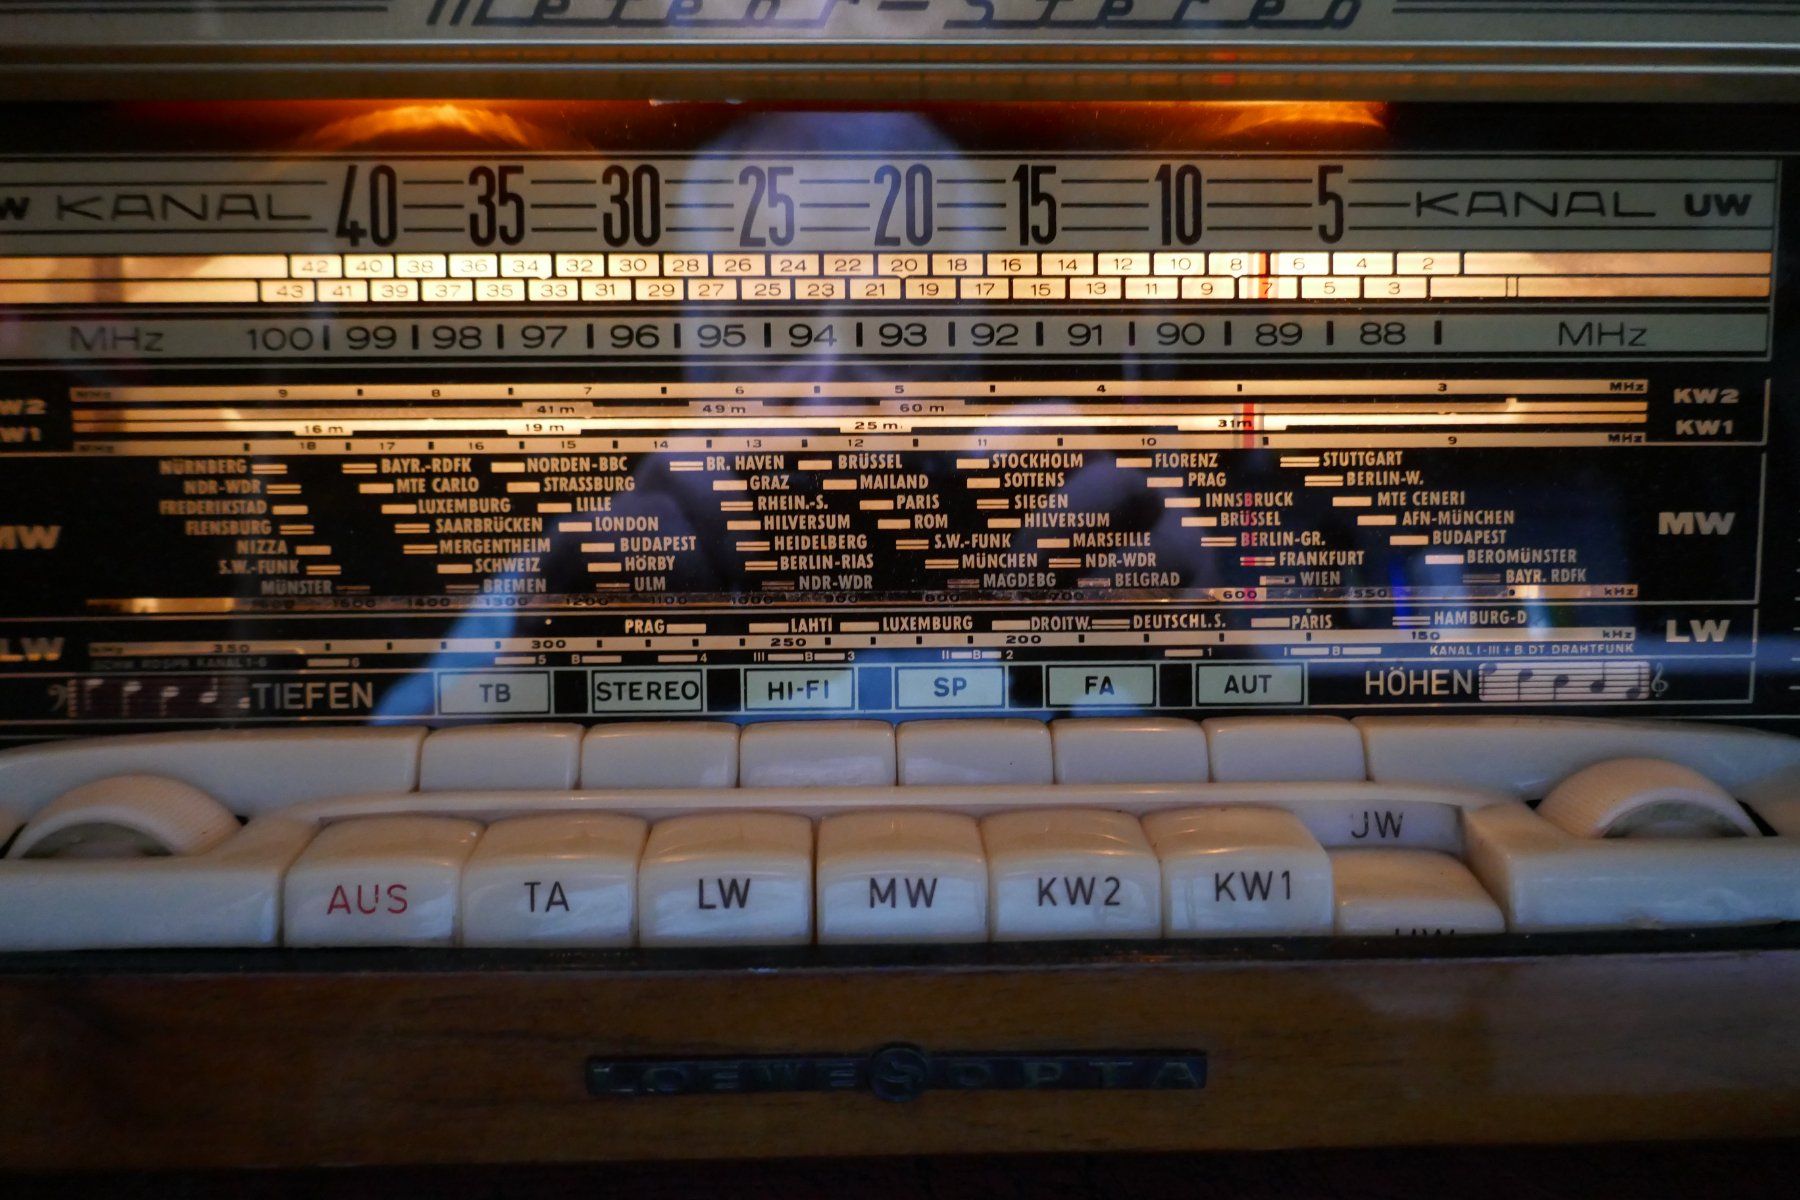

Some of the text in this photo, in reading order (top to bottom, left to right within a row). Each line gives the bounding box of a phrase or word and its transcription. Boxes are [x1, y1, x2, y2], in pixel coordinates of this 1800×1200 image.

[56, 164, 1752, 247] KANAL 40 35 30 25 20 15 10 5 KANAL UW
[672, 258, 1021, 272] 28 26 24 22 20 18 16
[648, 283, 995, 297] 29 27 25 23 21 19 17
[69, 321, 1646, 352] MHz 100 99 98 97 96 95 94 93 92 91 90 89 88 MHz
[1610, 382, 1644, 391] MHz
[1674, 388, 1739, 404] KW2
[537, 405, 554, 414] 41
[702, 405, 725, 414] 49
[900, 404, 923, 413] 60
[305, 425, 322, 434] 16
[525, 424, 543, 432] 19
[855, 422, 877, 430] 25
[1676, 420, 1734, 435] KW1
[300, 433, 1643, 450] 18 17 16 15 14 13 12 10 MHz
[381, 458, 472, 473] BAYR.-RDFK
[527, 456, 628, 472] NORDEN-BBC
[707, 455, 784, 471] BR. HAVEN
[838, 453, 902, 470] BRÜSSEL
[993, 453, 1083, 468] STOCKHOLM
[1155, 453, 1219, 468] FLORENZ
[1323, 451, 1403, 466] STUTTGART
[397, 478, 479, 493] MTE CARLO
[544, 477, 636, 492] STRASSBURG
[750, 475, 790, 490] GRAZ
[860, 474, 929, 489] MAILAND
[1004, 472, 1065, 488] SOTTENS
[1188, 472, 1227, 487] PRAG
[1346, 471, 1424, 486] BERLIN-W.
[184, 480, 261, 494] NDR-WDR
[418, 498, 511, 514] LUXEMBURG
[576, 497, 612, 512] LILLE
[757, 495, 828, 511] RHEIN.-S.
[897, 494, 940, 509] PARIS
[1015, 494, 1069, 509] SIEGEN
[1206, 492, 1293, 507] INNSBRUCK
[1377, 491, 1466, 506] MTE CENERI
[596, 517, 659, 532] LONDON
[764, 515, 850, 531] HILVERSUM
[914, 514, 948, 529] ROM
[1025, 512, 1110, 528] HILVERSUM
[1221, 511, 1281, 526] BRÜSSEL
[1402, 509, 1515, 525] AFN-MÜNCHEN
[1658, 512, 1735, 535] MW
[436, 517, 543, 533] SAARBRÜCKEN
[620, 536, 697, 552] BUDAPEST
[774, 535, 868, 550] HEIDELBERG
[934, 533, 1011, 549] S.W.-FUNK
[1073, 532, 1151, 548] MARSEILLE
[1241, 531, 1326, 546] BERLIN-GR.
[1433, 530, 1507, 545] BUDAPEST
[236, 540, 288, 555] NIZZA
[440, 538, 551, 554] MERGENTHEIM
[625, 555, 675, 571] HÖRBY
[780, 554, 874, 570] BERLIN-RIAS
[962, 553, 1038, 569] MÜNCHEN
[1086, 553, 1156, 568] NDR-WDR
[1279, 551, 1365, 566] FRANKFURT
[1467, 549, 1577, 564] BEROMÜNSTER
[219, 560, 299, 575] S.W.-FUNK
[475, 557, 541, 573] SCHWEIZ
[799, 576, 873, 590] NDR-WDR
[983, 572, 1056, 588] MAGDEBG
[1115, 572, 1180, 587] BELGRAD
[1301, 571, 1341, 586] WIEN
[1506, 568, 1587, 583] BAYR. RDFK
[261, 580, 332, 595] MÜNSTER
[483, 578, 547, 593] BREMEN
[635, 577, 666, 591] ULM
[1604, 587, 1634, 596] kHz
[1223, 590, 1257, 599] 600
[791, 617, 833, 633] LAHTI
[883, 616, 973, 632] LUXEMBURG
[1031, 616, 1091, 631] DROITW.
[1291, 614, 1333, 629] PARIS
[1434, 610, 1527, 626] HAMBURG-D
[625, 618, 665, 634] PRAG
[1666, 619, 1730, 643] LW
[1006, 635, 1042, 644] 200
[1412, 631, 1440, 640] 150
[1602, 629, 1632, 639] kHz
[532, 640, 567, 649] 300
[771, 638, 807, 647] 250
[1430, 646, 1472, 656] KANAL
[1551, 644, 1634, 655] DRAHTFUNK
[933, 677, 968, 698] SP
[1084, 675, 1115, 696] FA
[1223, 674, 1272, 694] AUT
[1365, 667, 1473, 696] HÖHEN
[251, 682, 373, 710] TIEFEN
[479, 684, 511, 702] TB
[596, 680, 700, 701] STEREO
[768, 679, 829, 701] HI-FI
[868, 876, 939, 909] MW
[1037, 876, 1122, 907] KW2
[1214, 870, 1293, 902] KW1
[327, 883, 408, 915] AUS
[524, 880, 571, 913] TA
[698, 877, 751, 911] LW
